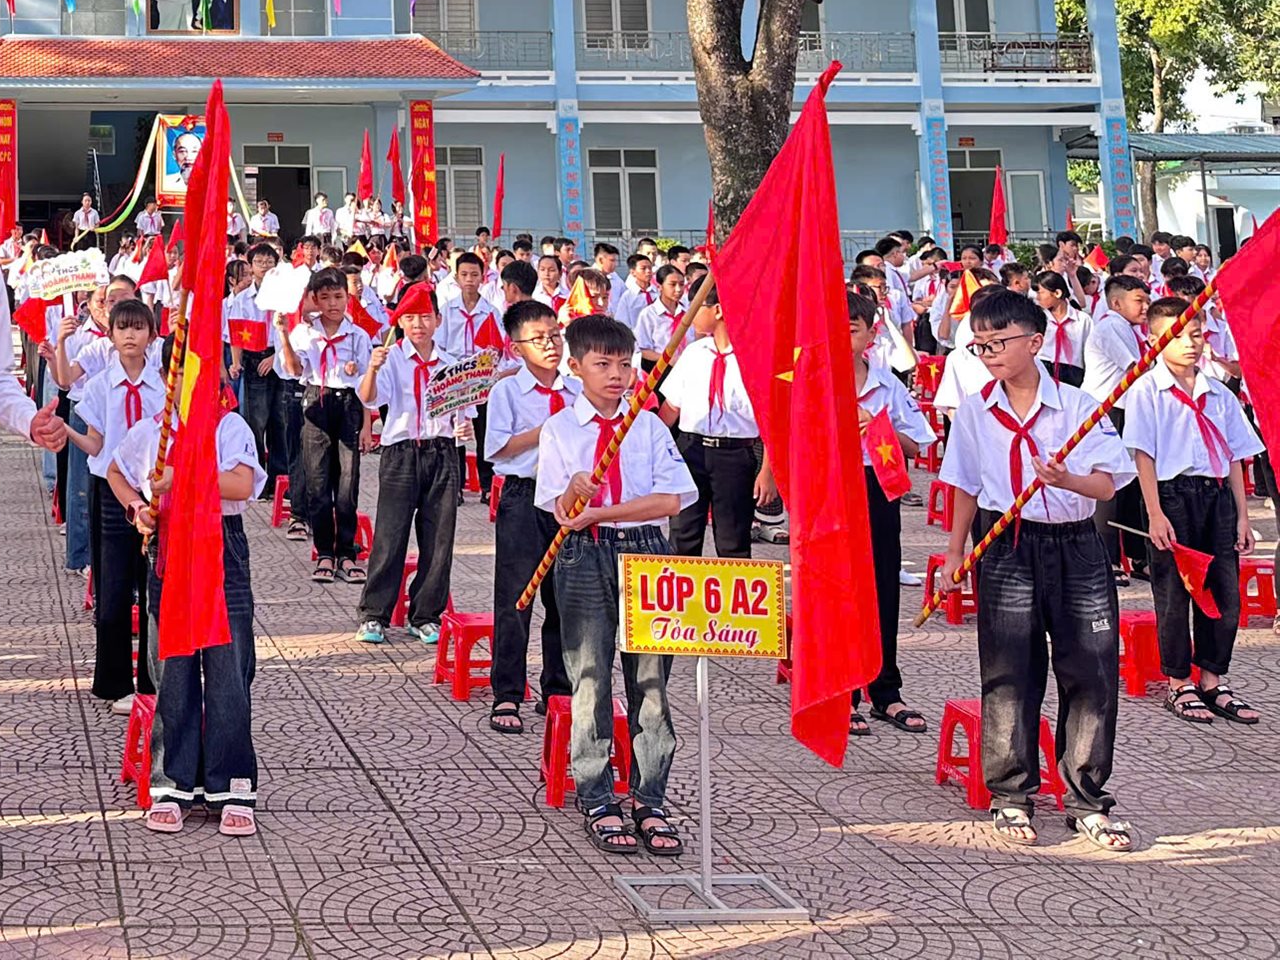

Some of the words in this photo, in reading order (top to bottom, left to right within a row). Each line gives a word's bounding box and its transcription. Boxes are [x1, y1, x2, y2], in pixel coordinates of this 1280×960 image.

[447, 360, 477, 376] THCS
[465, 369, 493, 380] THANH
[640, 567, 694, 612] LỚP
[704, 577, 721, 614] 6
[731, 578, 769, 616] A2
[651, 617, 697, 643] Tỏa
[703, 619, 759, 649] Sáng
